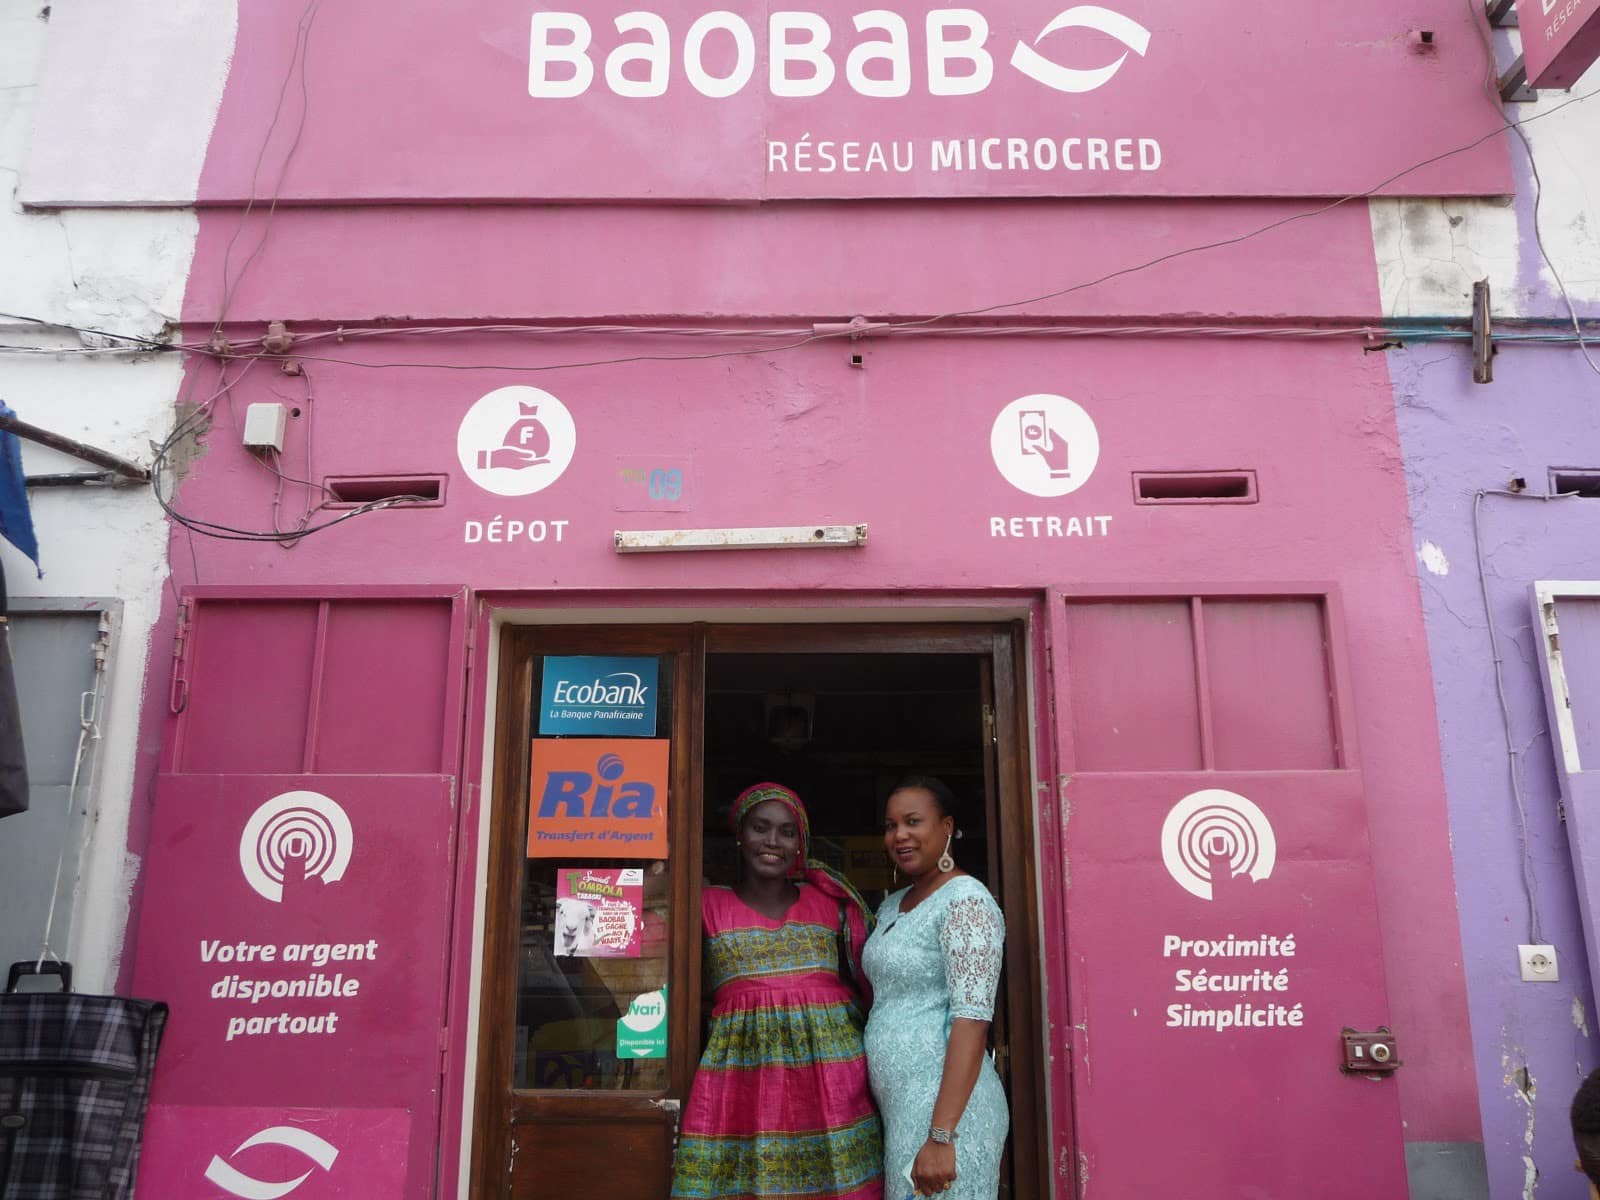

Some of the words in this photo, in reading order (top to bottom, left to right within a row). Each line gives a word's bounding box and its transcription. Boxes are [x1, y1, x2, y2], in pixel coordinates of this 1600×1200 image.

[768, 132, 913, 172] RÉSEAU
[931, 138, 1162, 171] MICROCRED
[650, 468, 682, 500] 09
[464, 514, 569, 543] DÉPOT
[990, 515, 1113, 538] RETRAIT
[554, 672, 648, 704] Ecobank
[550, 710, 559, 718] La
[561, 710, 592, 720] Banque
[594, 710, 643, 720] Panafricaine
[538, 754, 655, 818] Ria
[536, 831, 594, 842] Transfert
[567, 873, 623, 897] TOMBOLA
[200, 939, 277, 962] Votre
[282, 939, 378, 967] argent
[1163, 933, 1296, 957] Proximité
[211, 973, 360, 1004] disponible
[1175, 968, 1288, 992] Sécurité
[226, 1012, 339, 1042] partout
[1166, 1002, 1304, 1032] Simplicité
